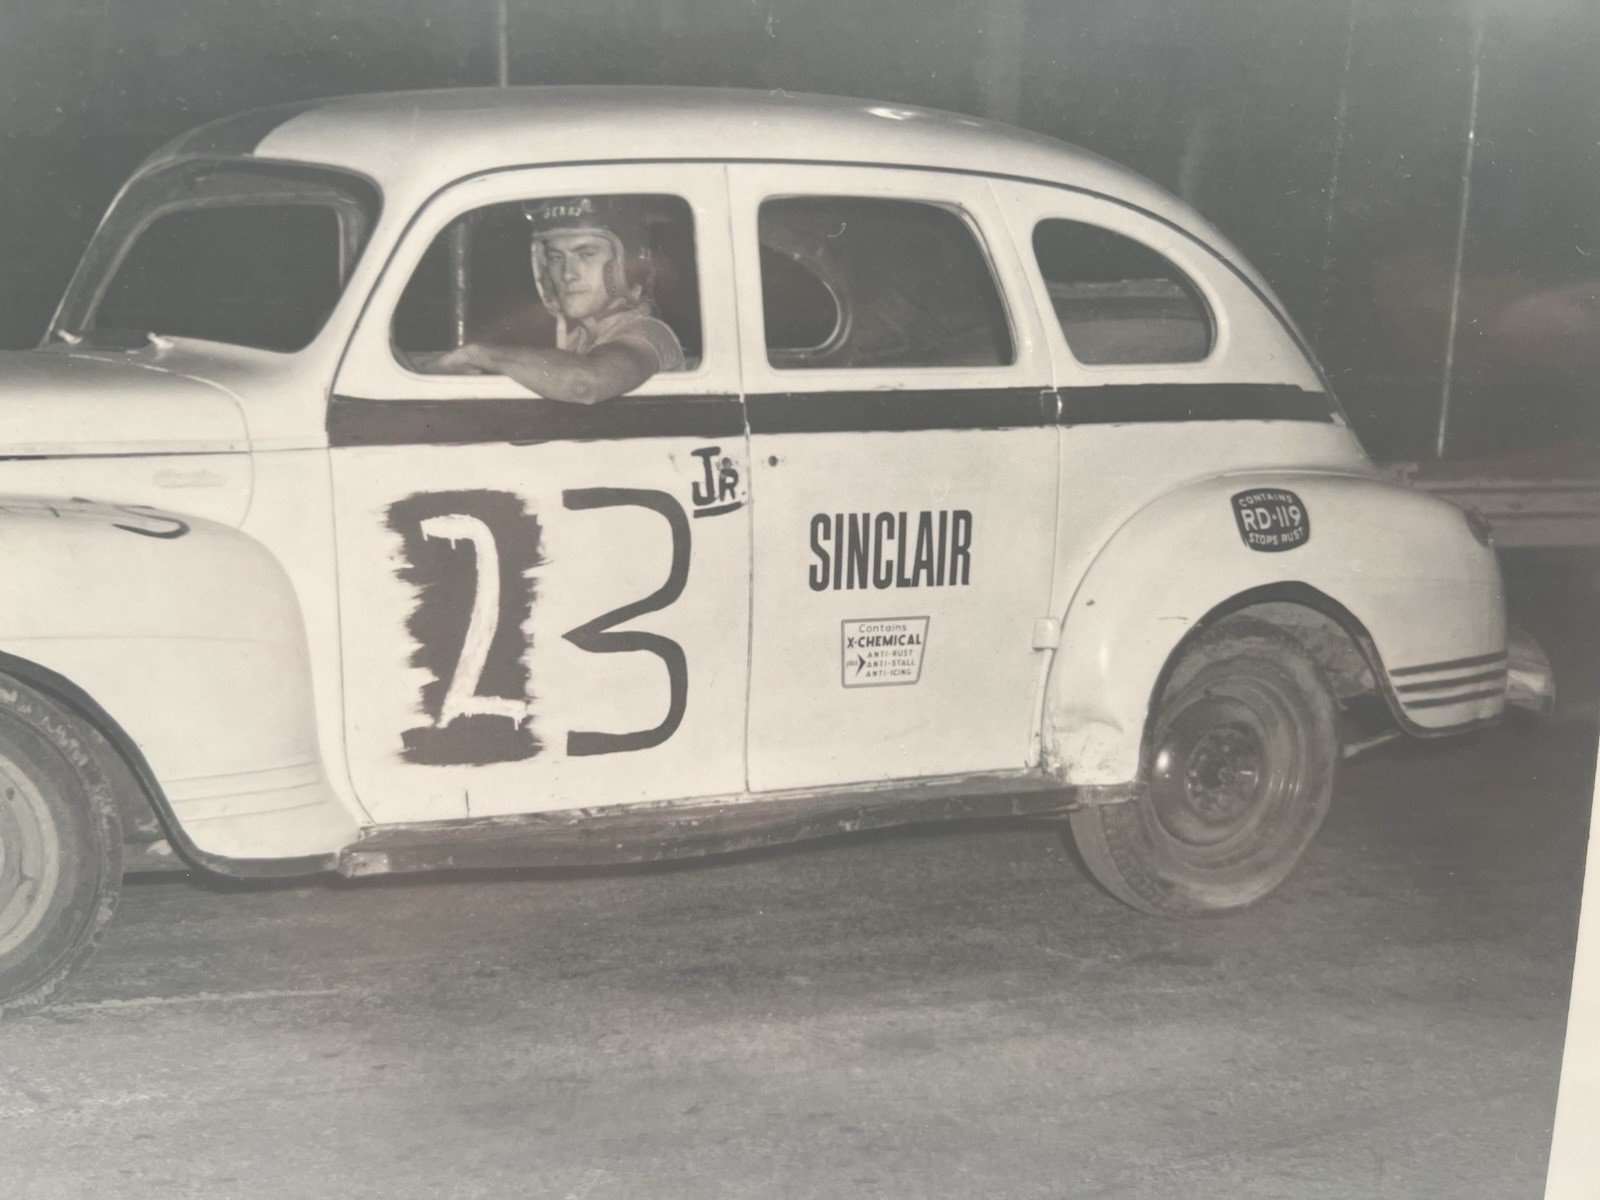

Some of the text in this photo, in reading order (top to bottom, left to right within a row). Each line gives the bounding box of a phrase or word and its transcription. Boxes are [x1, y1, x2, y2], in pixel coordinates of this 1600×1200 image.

[1238, 493, 1293, 507] CONTAINS
[1248, 527, 1304, 546] STOPS RUST
[808, 509, 973, 592] SINCLAIR
[412, 486, 692, 757] 23
[858, 623, 908, 633] Contains
[847, 633, 922, 649] X-CHEMICAL
[867, 649, 914, 658] ANTI-RUST
[866, 659, 915, 668] ANTI-STALL
[865, 668, 912, 677] ANTI-ICING
